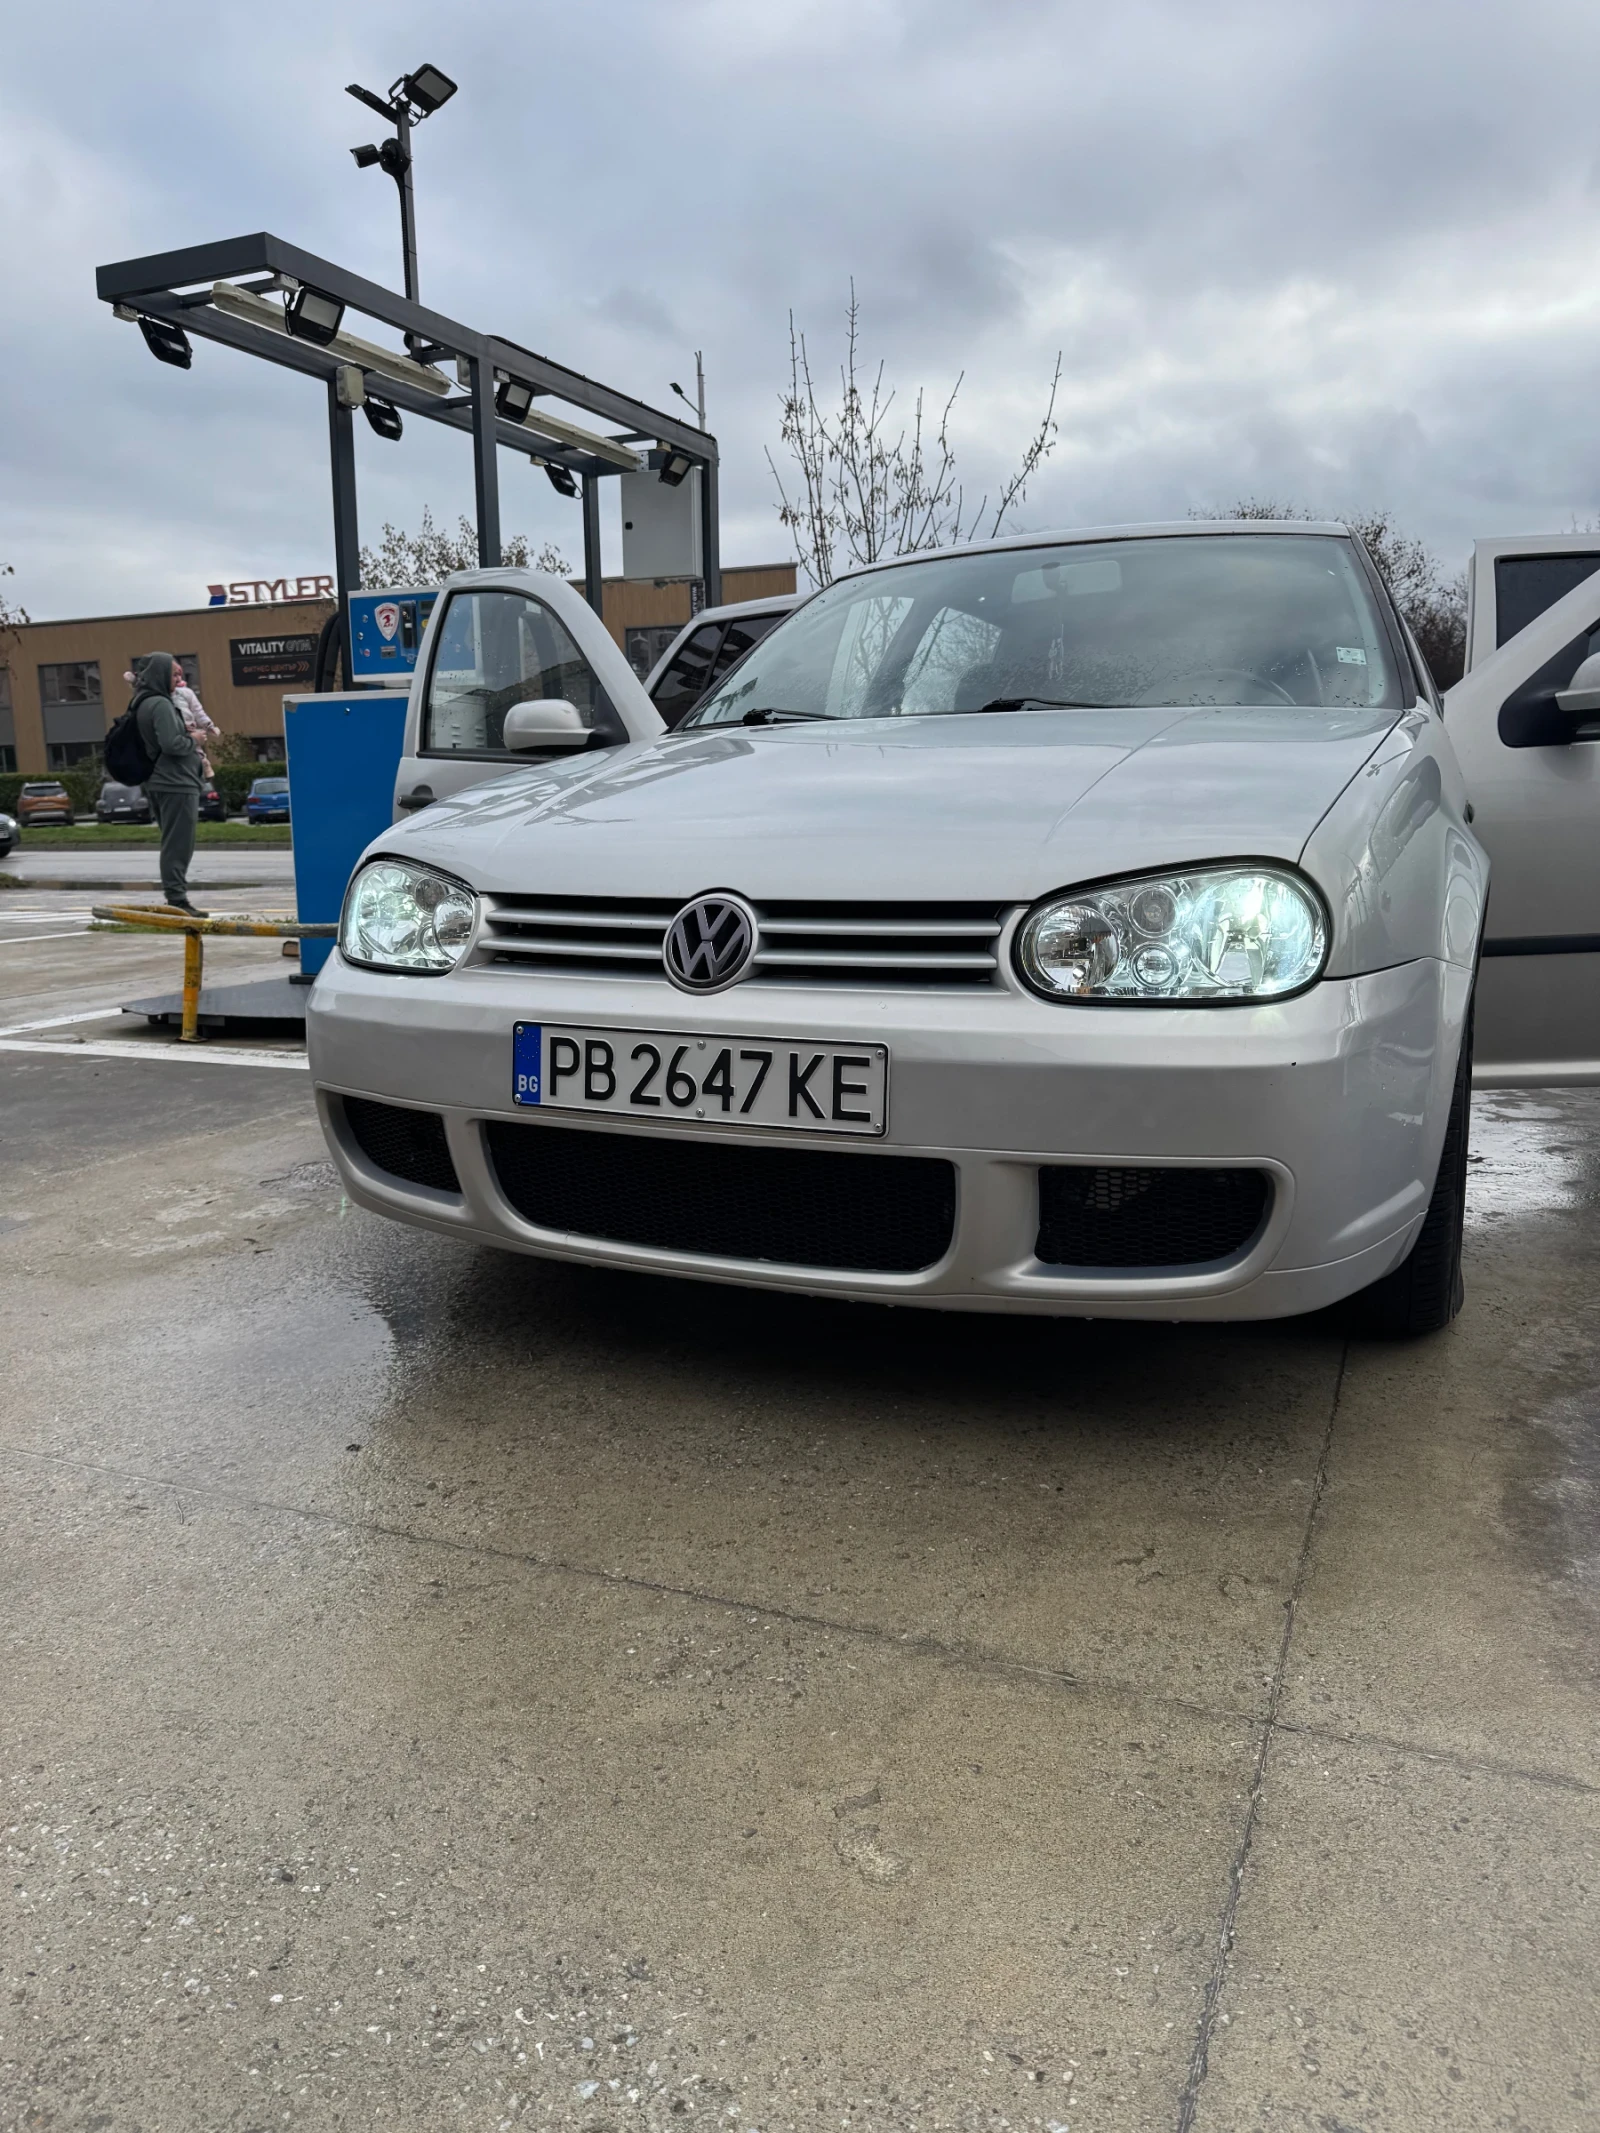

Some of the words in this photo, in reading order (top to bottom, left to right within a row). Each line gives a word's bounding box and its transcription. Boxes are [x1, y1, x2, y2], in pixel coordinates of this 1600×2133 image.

[229, 575, 338, 605] STYLER
[238, 641, 285, 655] VITALITY
[286, 639, 312, 652] GYM
[667, 897, 751, 984] VW
[517, 1074, 539, 1093] BG
[550, 1036, 617, 1101] PB
[629, 1043, 774, 1113] 2647
[788, 1051, 872, 1123] KE
